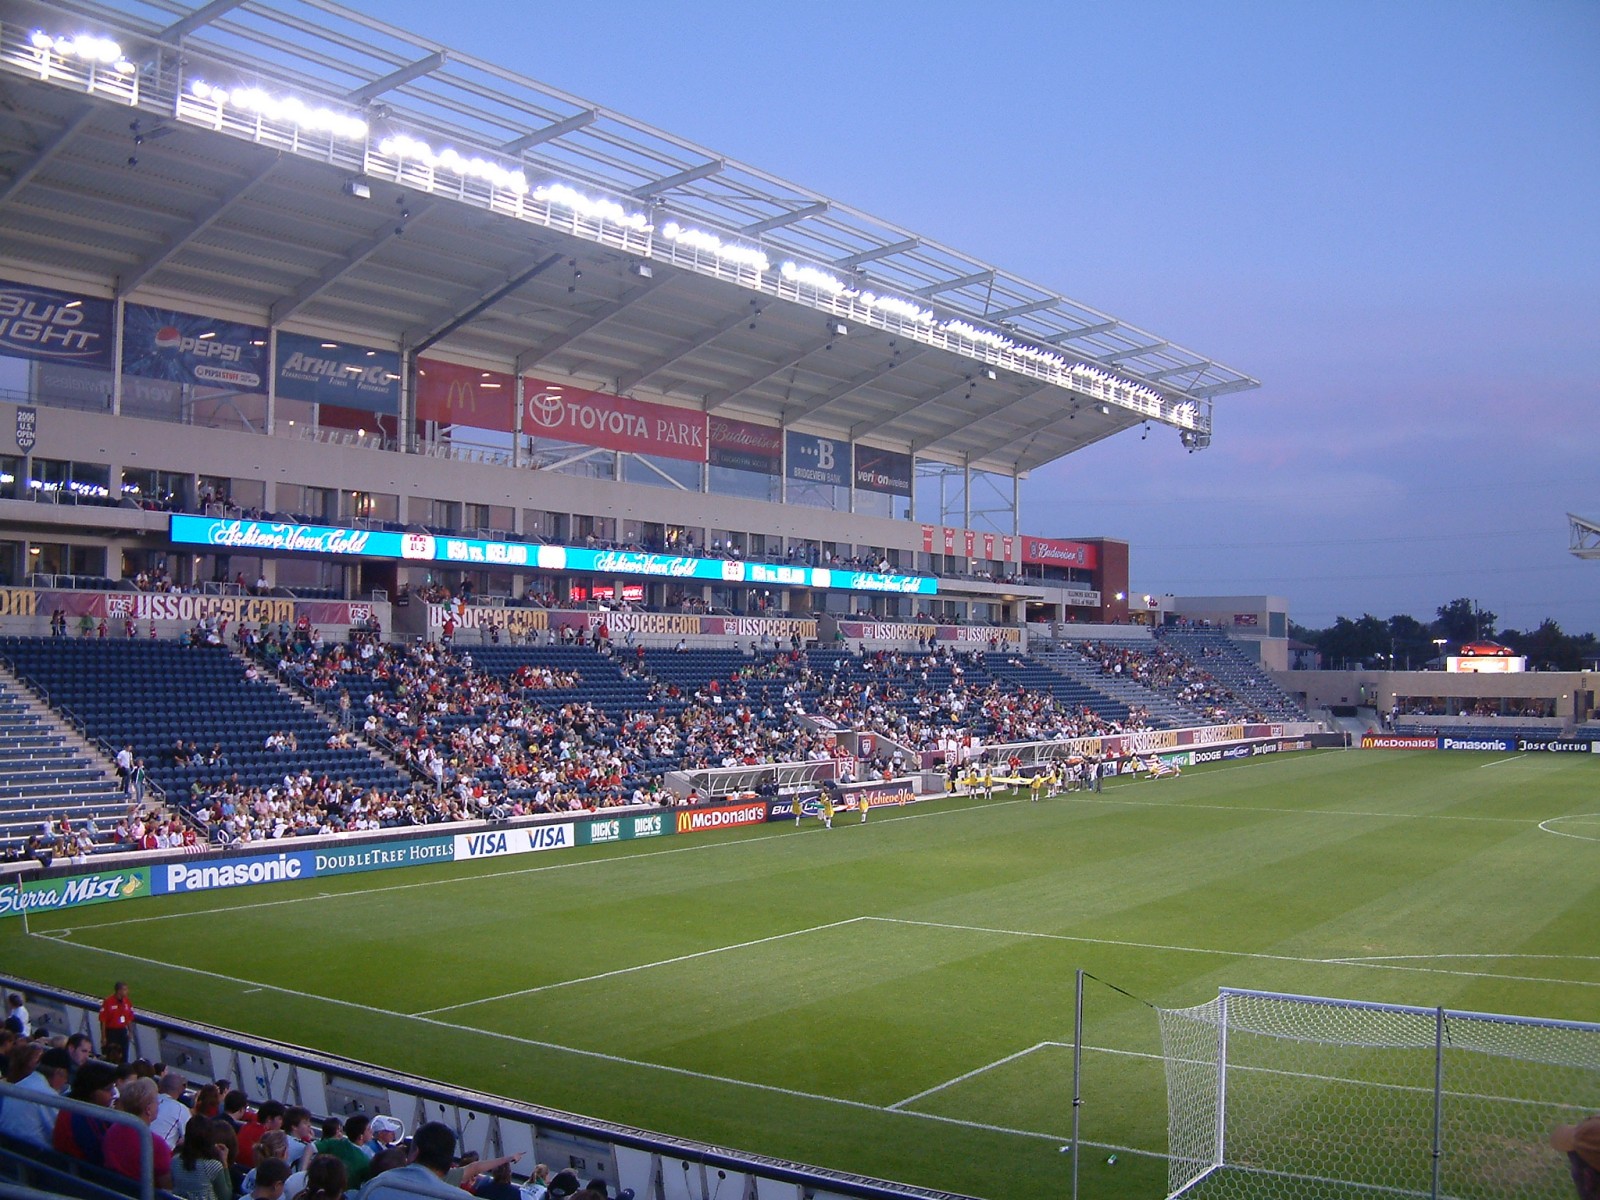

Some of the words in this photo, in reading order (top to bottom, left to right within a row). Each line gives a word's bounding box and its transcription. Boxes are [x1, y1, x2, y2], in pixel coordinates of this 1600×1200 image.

[0, 294, 83, 326] BUD
[179, 337, 241, 361] PEPSI
[17, 430, 35, 439] OPEN
[568, 403, 649, 439] TOYOTA
[657, 419, 703, 448] PARK
[709, 421, 781, 449] Budweiser
[18, 438, 34, 447] CUP
[793, 466, 826, 482] BRIDGEVIEW
[827, 473, 841, 484] BANK
[1038, 543, 1077, 560] Budweiser
[136, 595, 294, 623] ussoccer.com
[606, 613, 700, 634] ussoccer.com
[739, 618, 817, 637] ussoccer.com
[875, 624, 936, 640] ussoccer.com
[967, 627, 1021, 643] ussoccer.com
[1130, 732, 1178, 751] ussoccer.com
[1373, 738, 1436, 748] McDonald's
[1444, 738, 1506, 751] Panasonic
[1196, 750, 1221, 762] DODGE
[635, 814, 661, 833] DICK'S
[692, 806, 765, 828] McDonald's
[591, 818, 619, 838] DICK'S
[466, 833, 507, 856] VISA
[527, 827, 566, 849] VISA
[167, 853, 302, 891] Panasonic
[0, 887, 59, 913] Sierra
[59, 876, 124, 907] Mist
